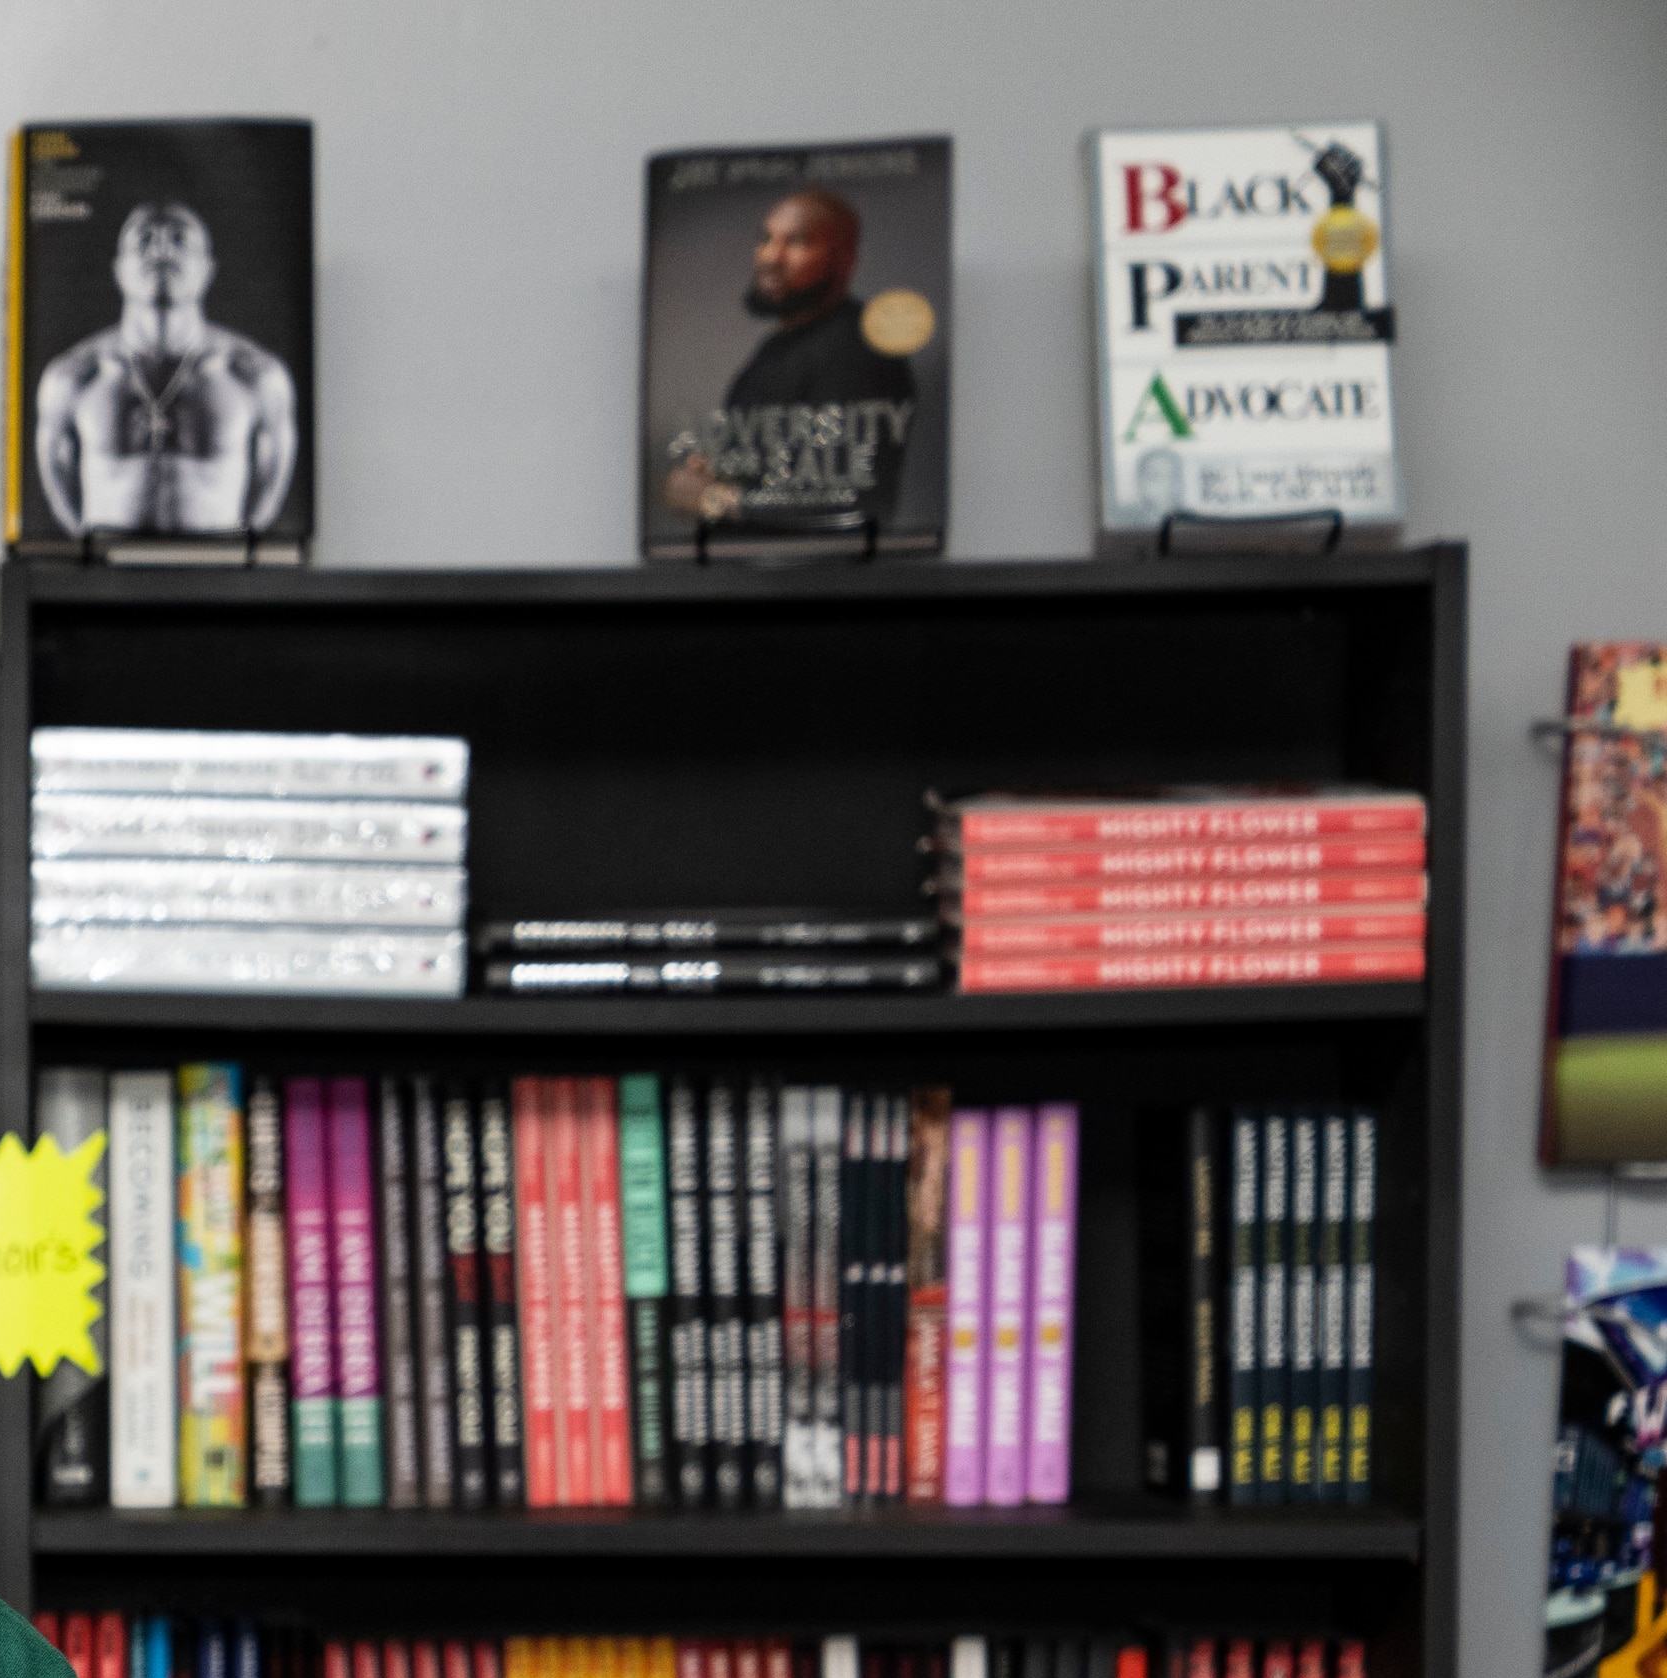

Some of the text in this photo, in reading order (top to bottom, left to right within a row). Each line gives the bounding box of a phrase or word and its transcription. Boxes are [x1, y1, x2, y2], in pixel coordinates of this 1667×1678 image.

[1121, 161, 1311, 235] BLACK
[1126, 260, 1311, 330] PARENT
[1121, 371, 1379, 443] ADVOCATE
[127, 1094, 154, 1282] BECOMING
